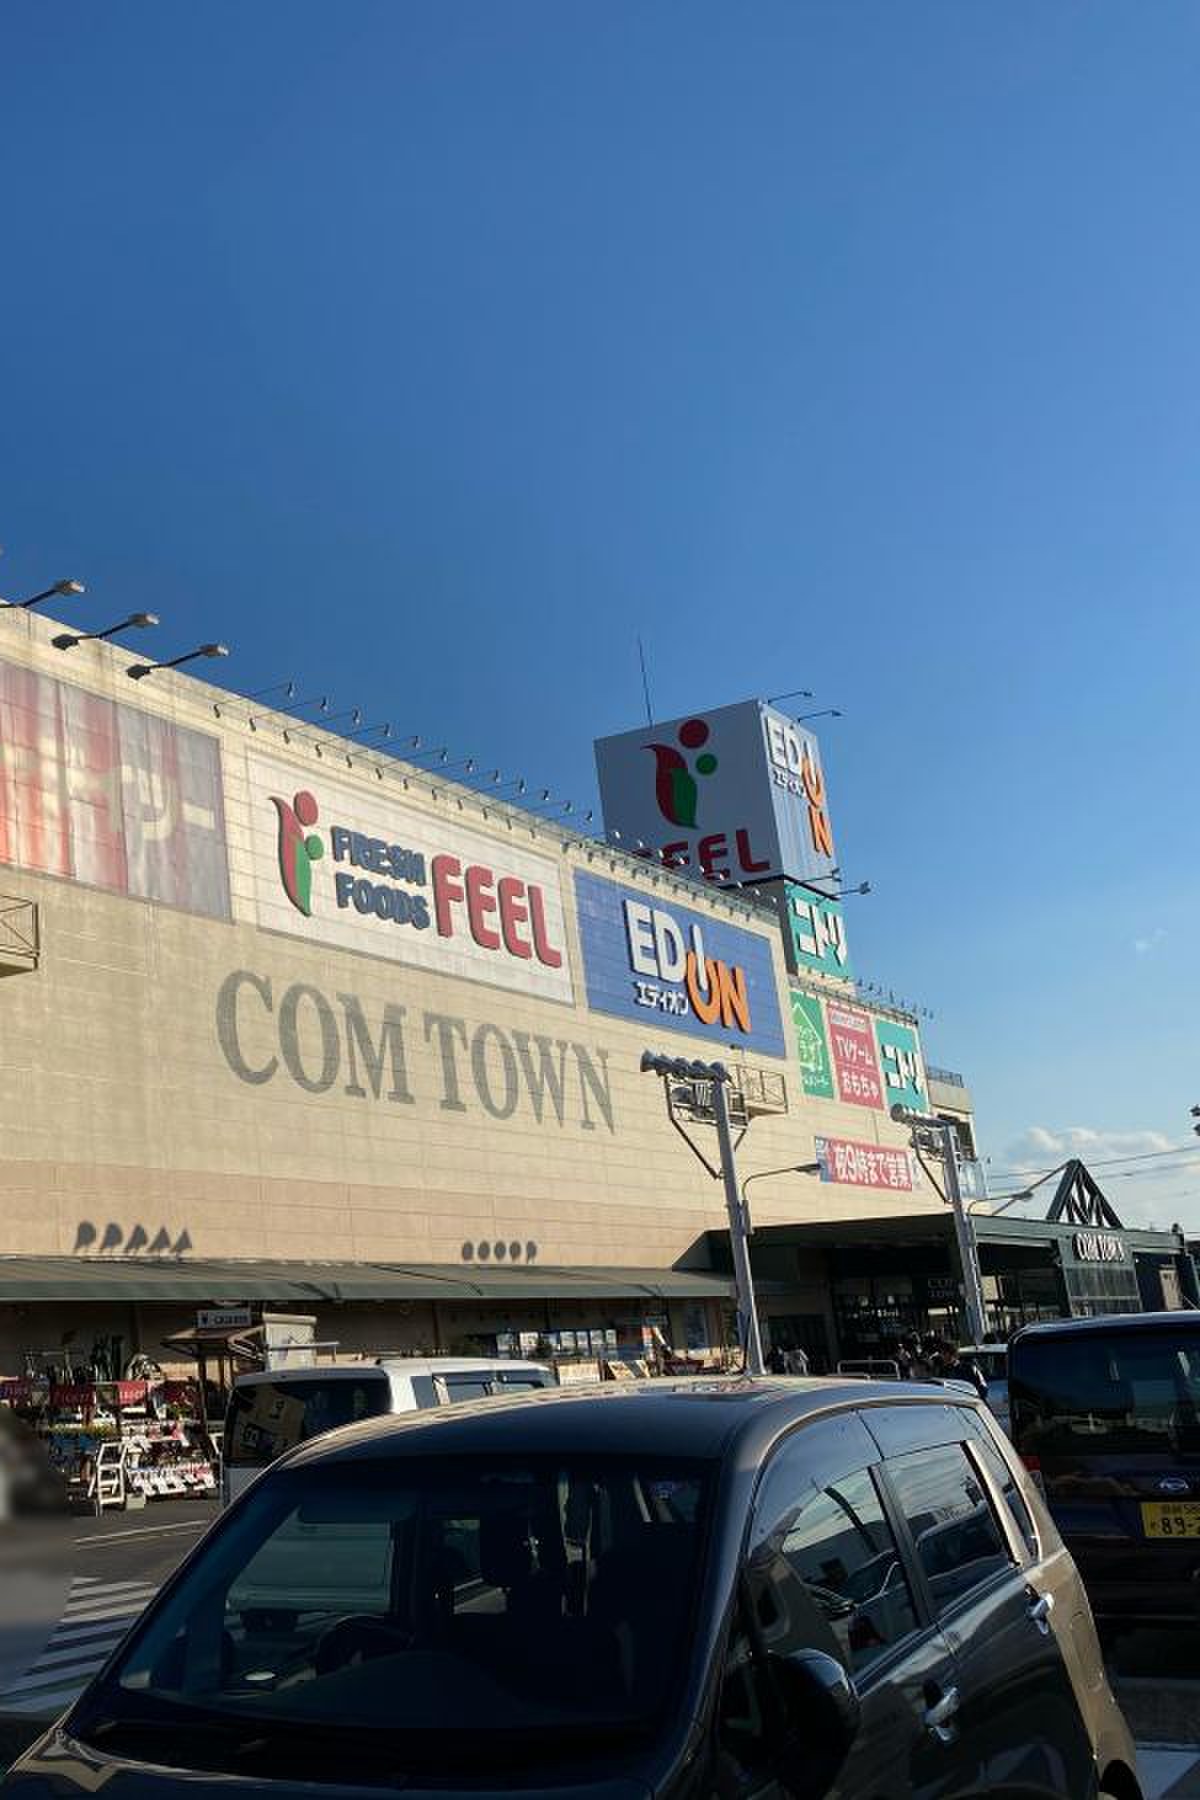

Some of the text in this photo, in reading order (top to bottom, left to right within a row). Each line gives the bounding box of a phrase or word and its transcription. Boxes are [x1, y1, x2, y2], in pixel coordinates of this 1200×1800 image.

[331, 825, 426, 887] FRESH
[632, 829, 771, 881] EEL
[335, 872, 431, 930] FOODS
[432, 854, 562, 969] FEEL
[791, 896, 848, 967] ニトリ
[634, 980, 690, 1016] エディオン
[216, 970, 615, 1135] COM TOWN
[882, 1044, 925, 1095] ニトリ
